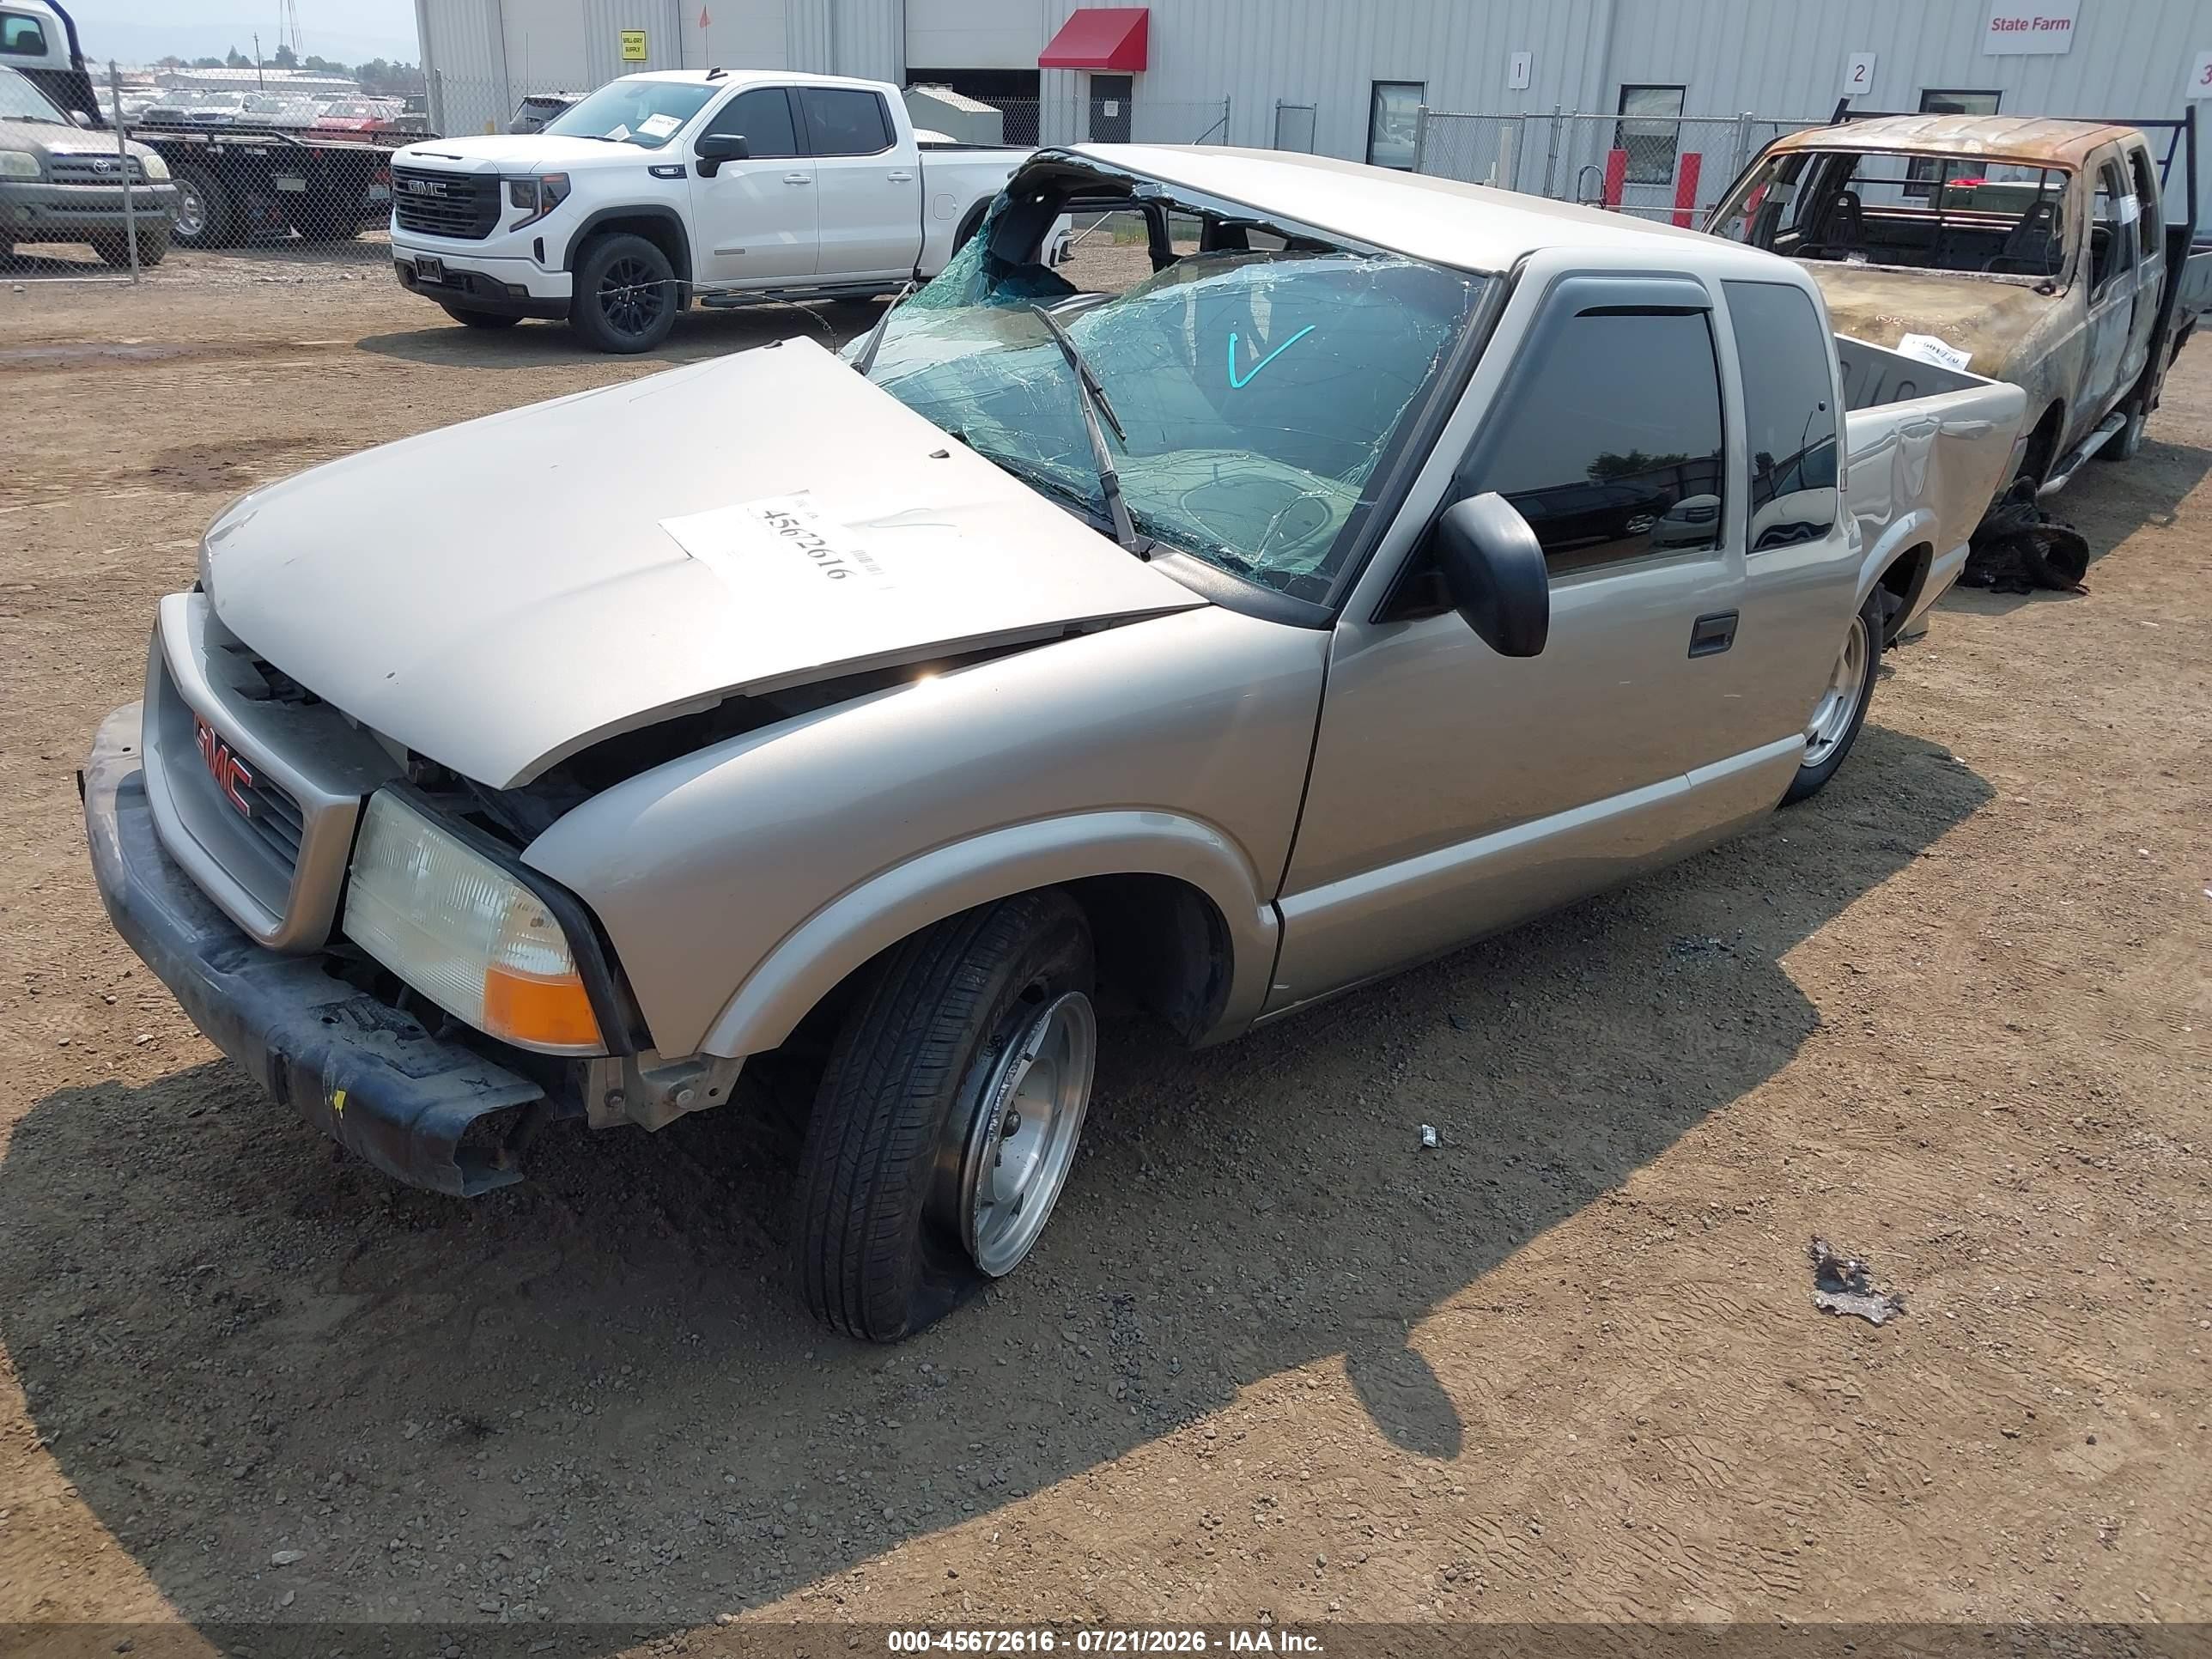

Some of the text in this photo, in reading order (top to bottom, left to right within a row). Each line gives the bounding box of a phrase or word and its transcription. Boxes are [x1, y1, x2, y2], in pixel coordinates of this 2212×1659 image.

[1991, 16, 2071, 32] State Farm
[1517, 62, 1522, 79] 1
[1853, 64, 1866, 82] 2
[2199, 64, 2212, 85] 3
[407, 179, 448, 198] GMC
[763, 508, 859, 580] 45672616
[191, 711, 253, 818] GMC
